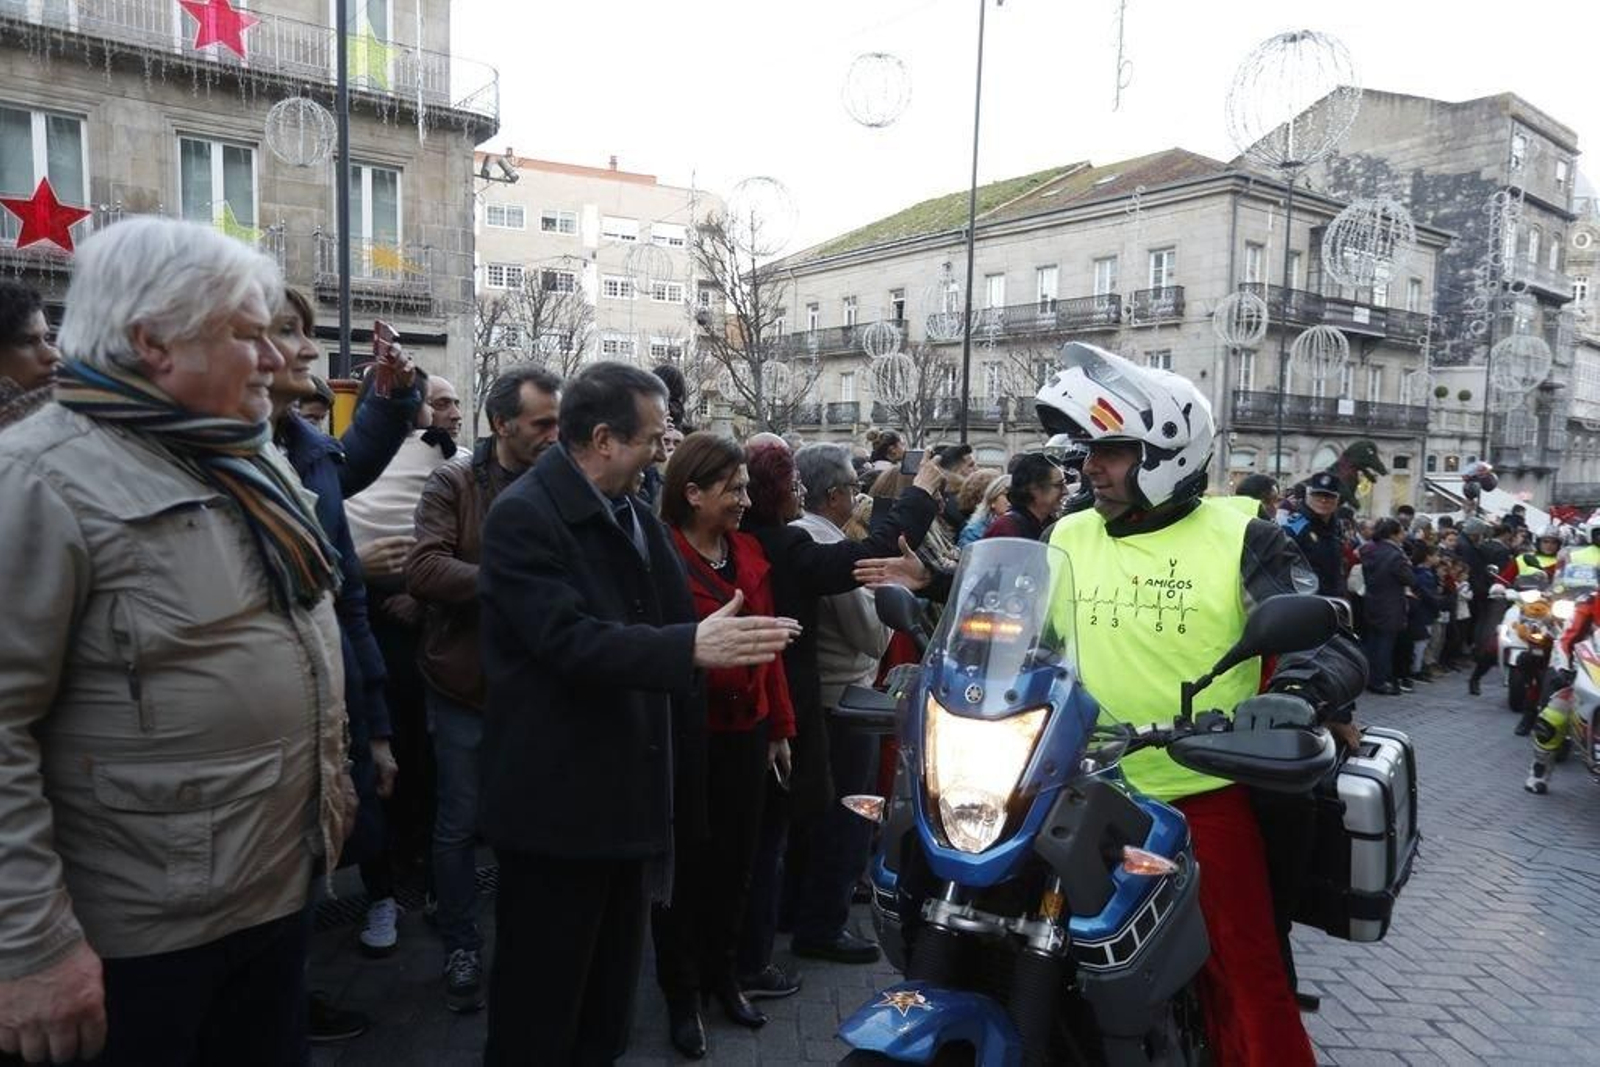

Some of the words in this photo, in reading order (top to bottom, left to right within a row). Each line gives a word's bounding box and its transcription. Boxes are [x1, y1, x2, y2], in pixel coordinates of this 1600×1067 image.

[1131, 575, 1139, 587] 4
[1145, 578, 1193, 590] AMIGOS
[1090, 614, 1098, 626] 2
[1111, 617, 1119, 629] 3
[1155, 622, 1163, 633] 5
[1177, 624, 1187, 635] 6
